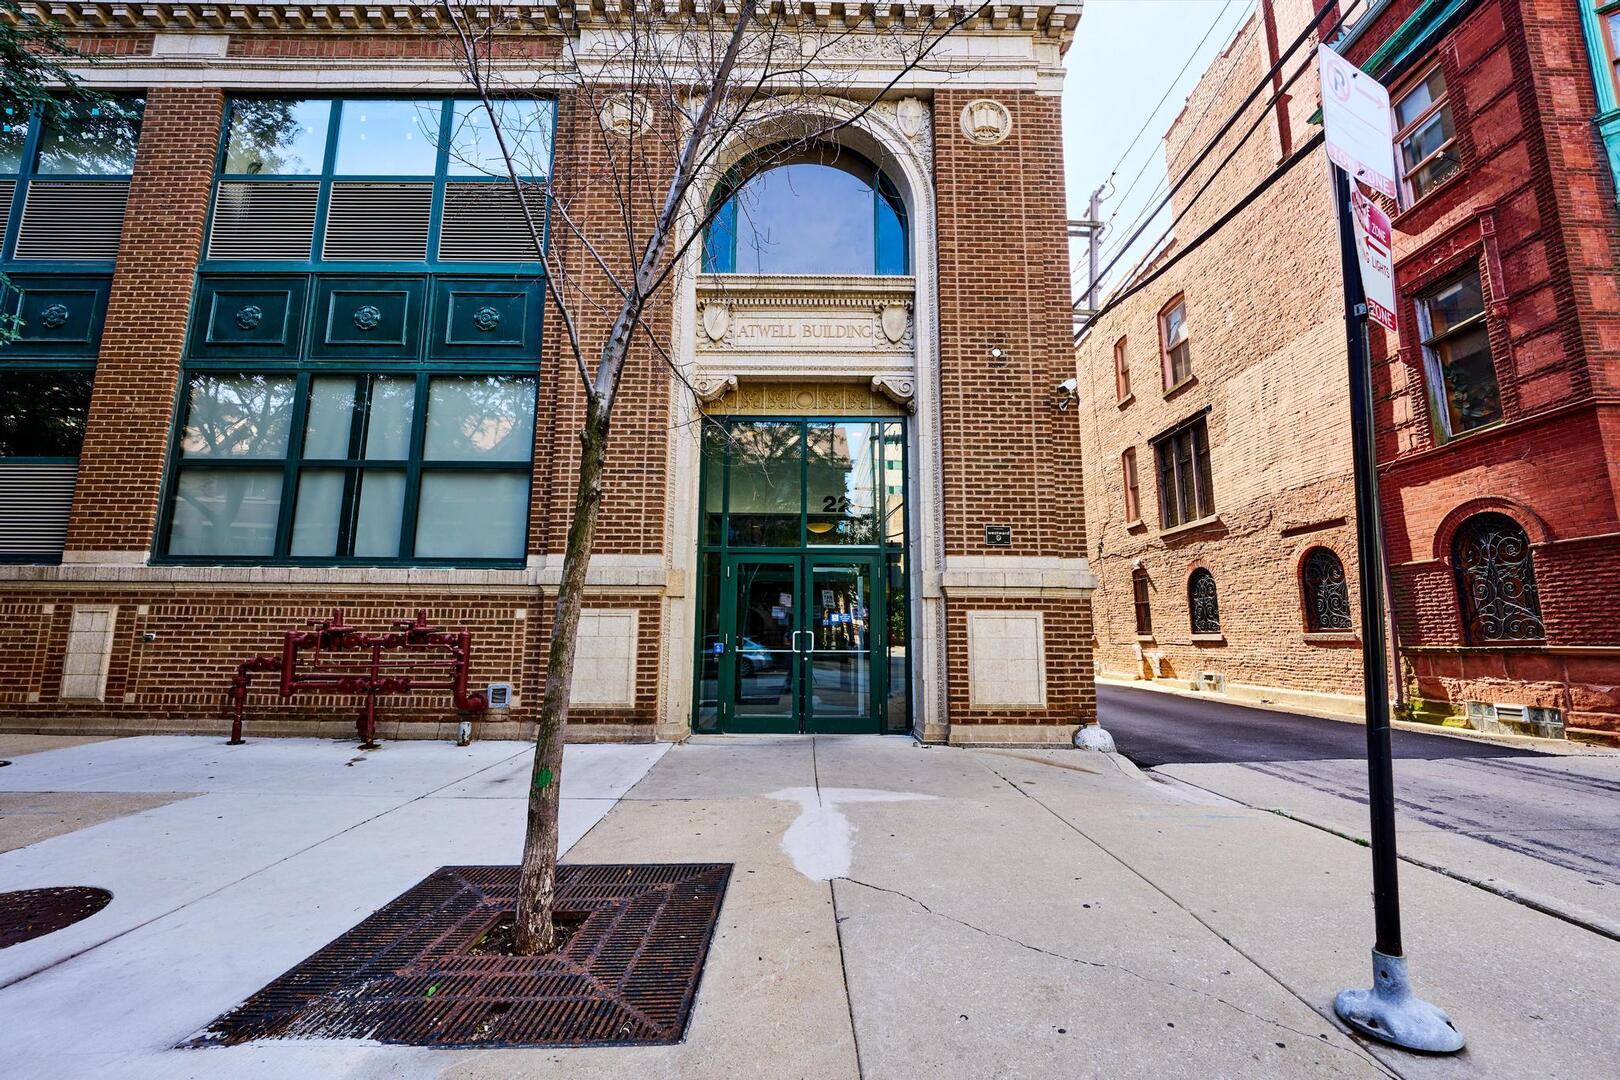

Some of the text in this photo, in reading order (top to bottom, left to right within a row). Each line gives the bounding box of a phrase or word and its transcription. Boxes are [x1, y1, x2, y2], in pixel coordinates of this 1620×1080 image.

[1368, 299, 1394, 329] ZONE
[737, 324, 871, 338] ATWELL BUILDING
